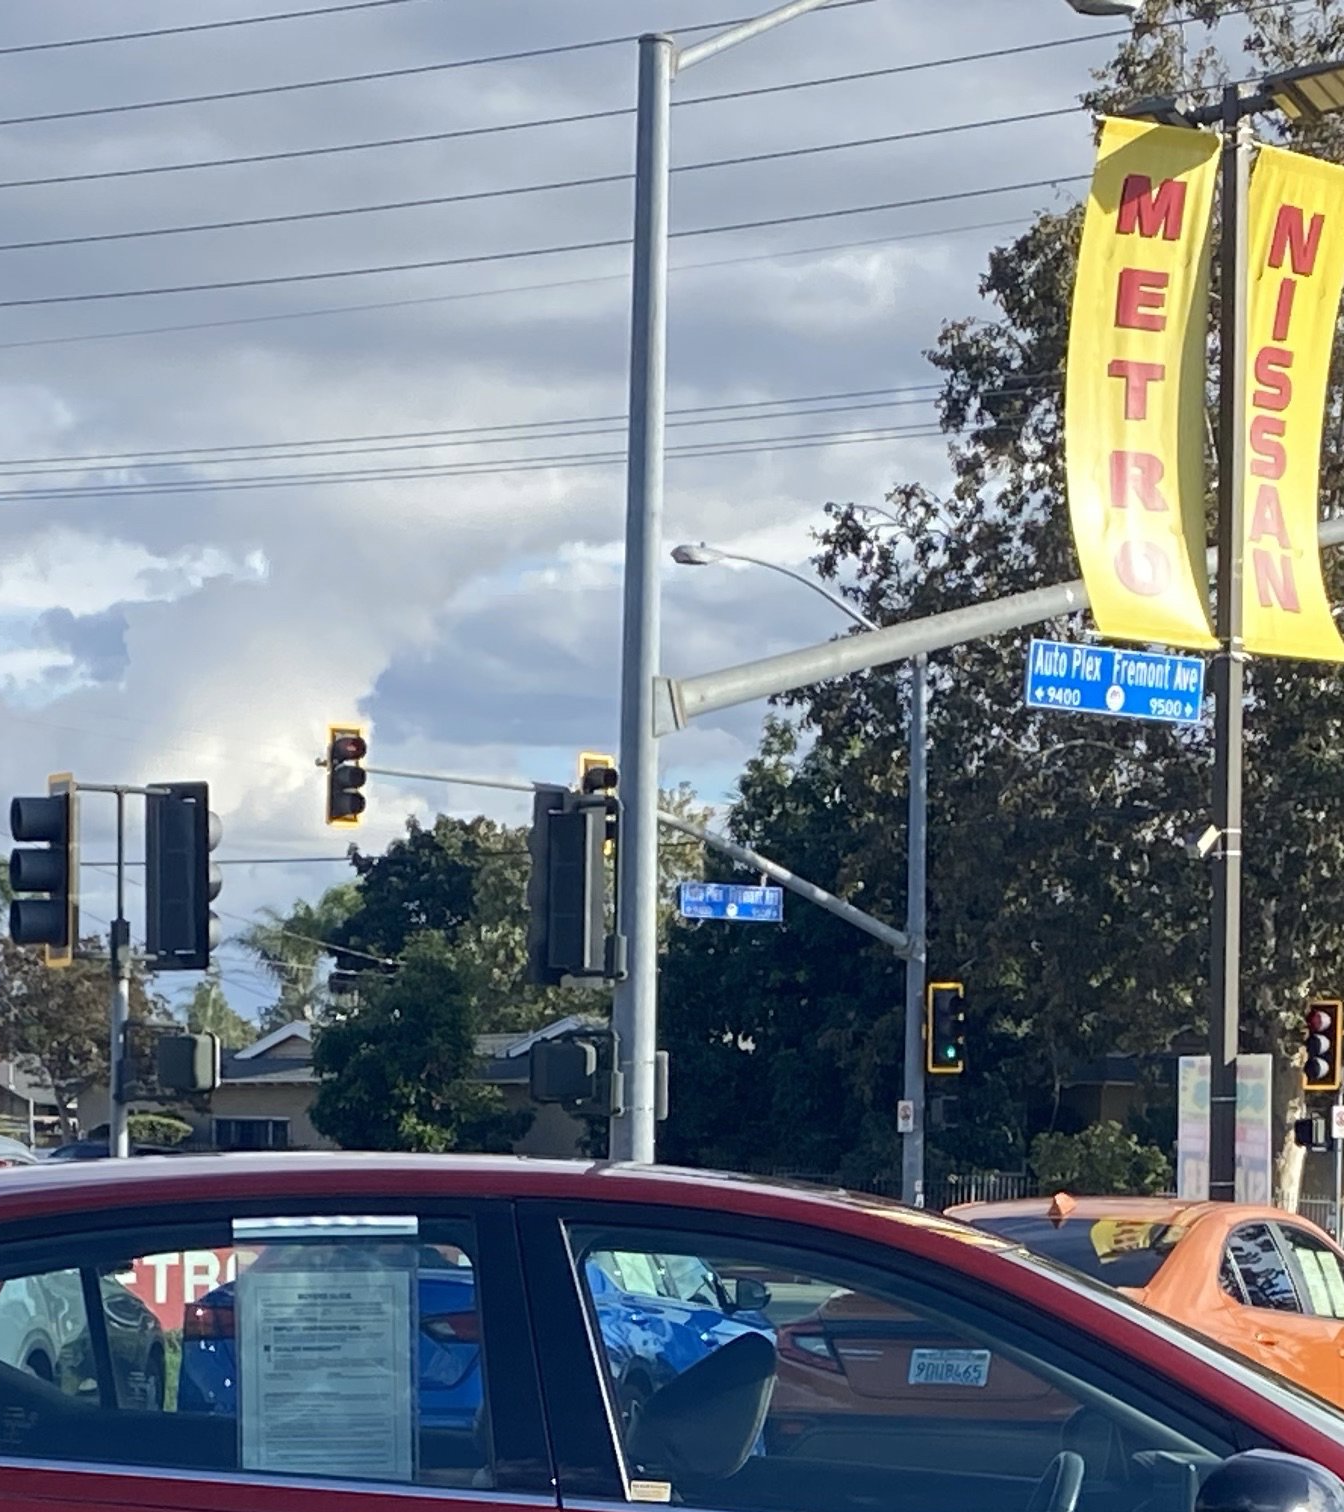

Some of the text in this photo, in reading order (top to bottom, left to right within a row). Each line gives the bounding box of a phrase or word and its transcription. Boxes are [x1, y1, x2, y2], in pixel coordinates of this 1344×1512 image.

[1108, 174, 1188, 597] METRO
[1249, 205, 1325, 613] NISSAN
[1034, 645, 1198, 693] Auto Plex Fremont Ave
[1047, 686, 1081, 706] 9400
[1150, 697, 1182, 716] 9500
